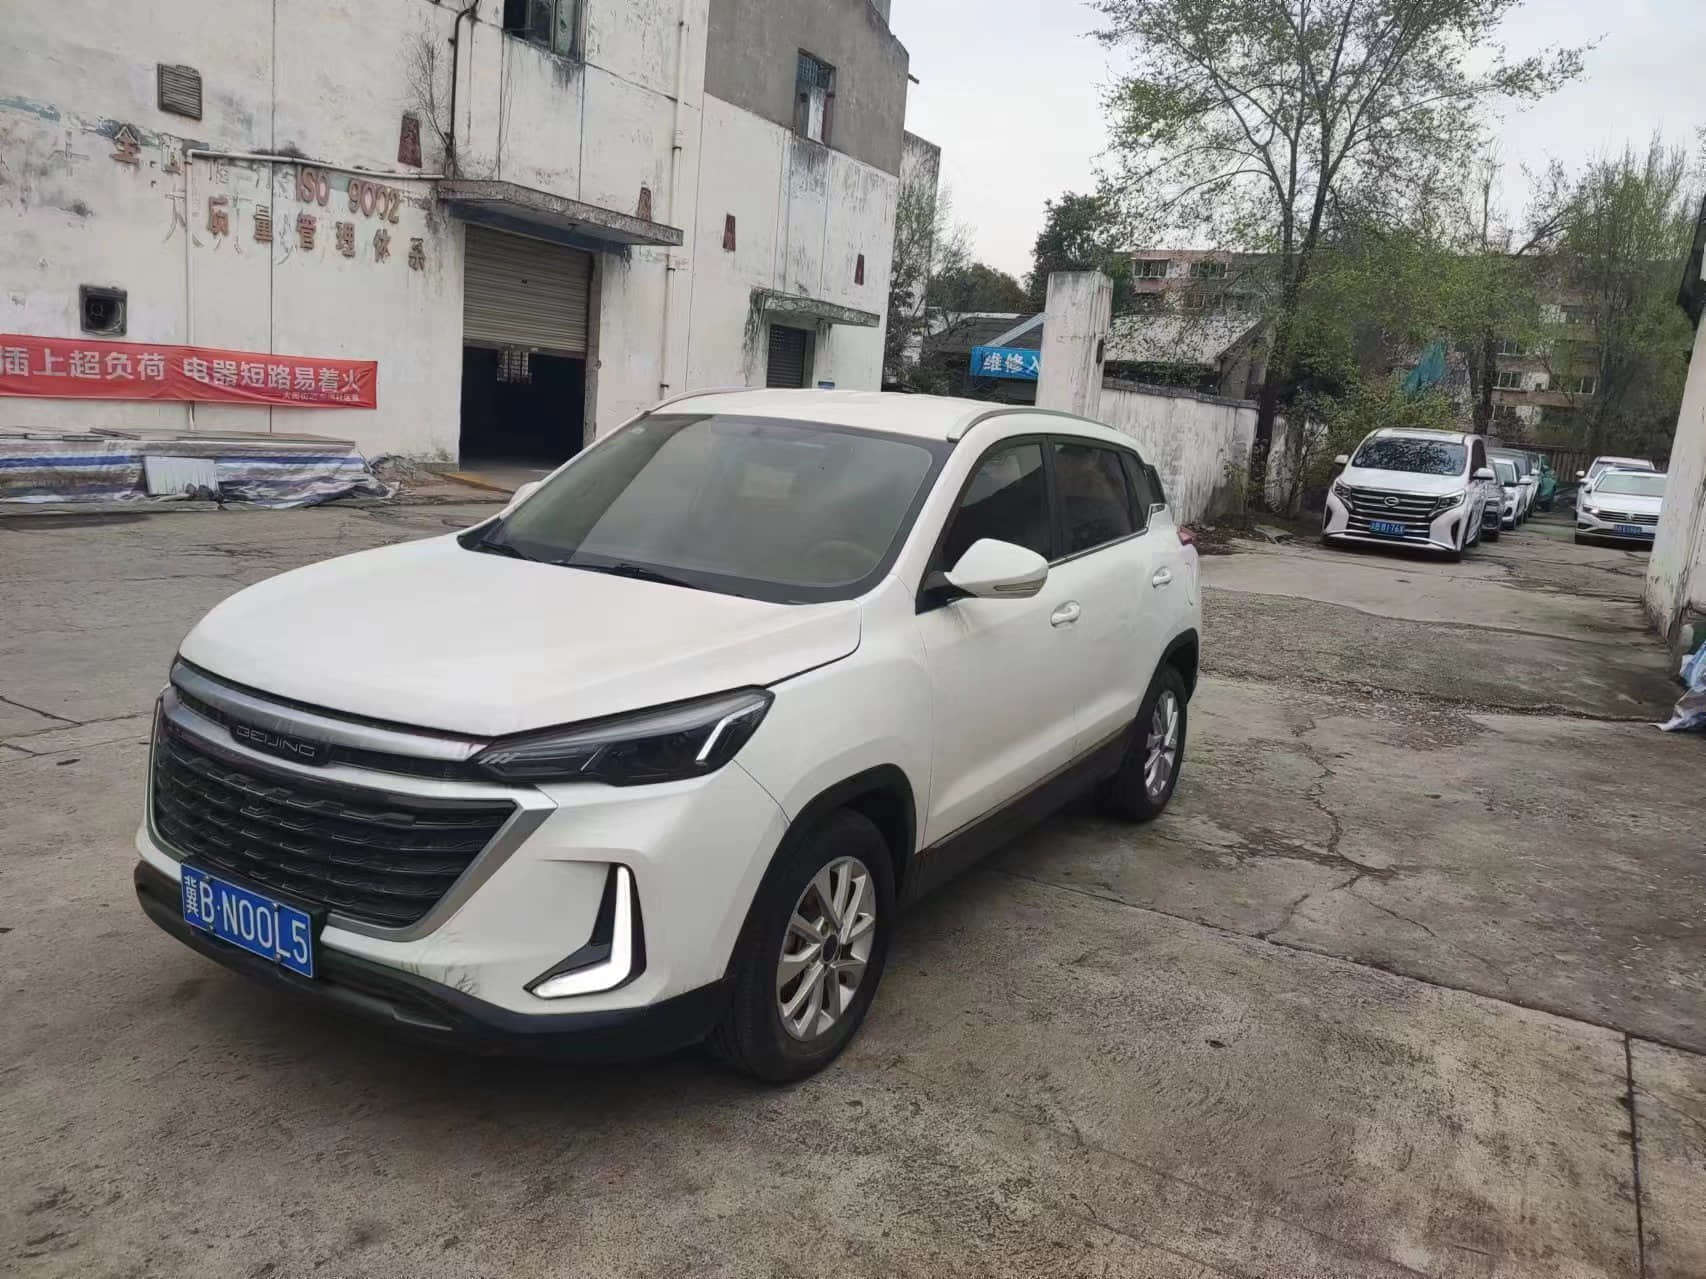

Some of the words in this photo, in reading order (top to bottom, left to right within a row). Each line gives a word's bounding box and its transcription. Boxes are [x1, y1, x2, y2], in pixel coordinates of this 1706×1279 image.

[296, 166, 331, 207] ISO
[348, 178, 401, 224] 9002
[0, 346, 165, 381] 插上超负荷
[183, 356, 361, 392] 电器短路易着火
[236, 725, 316, 757] BEIJING
